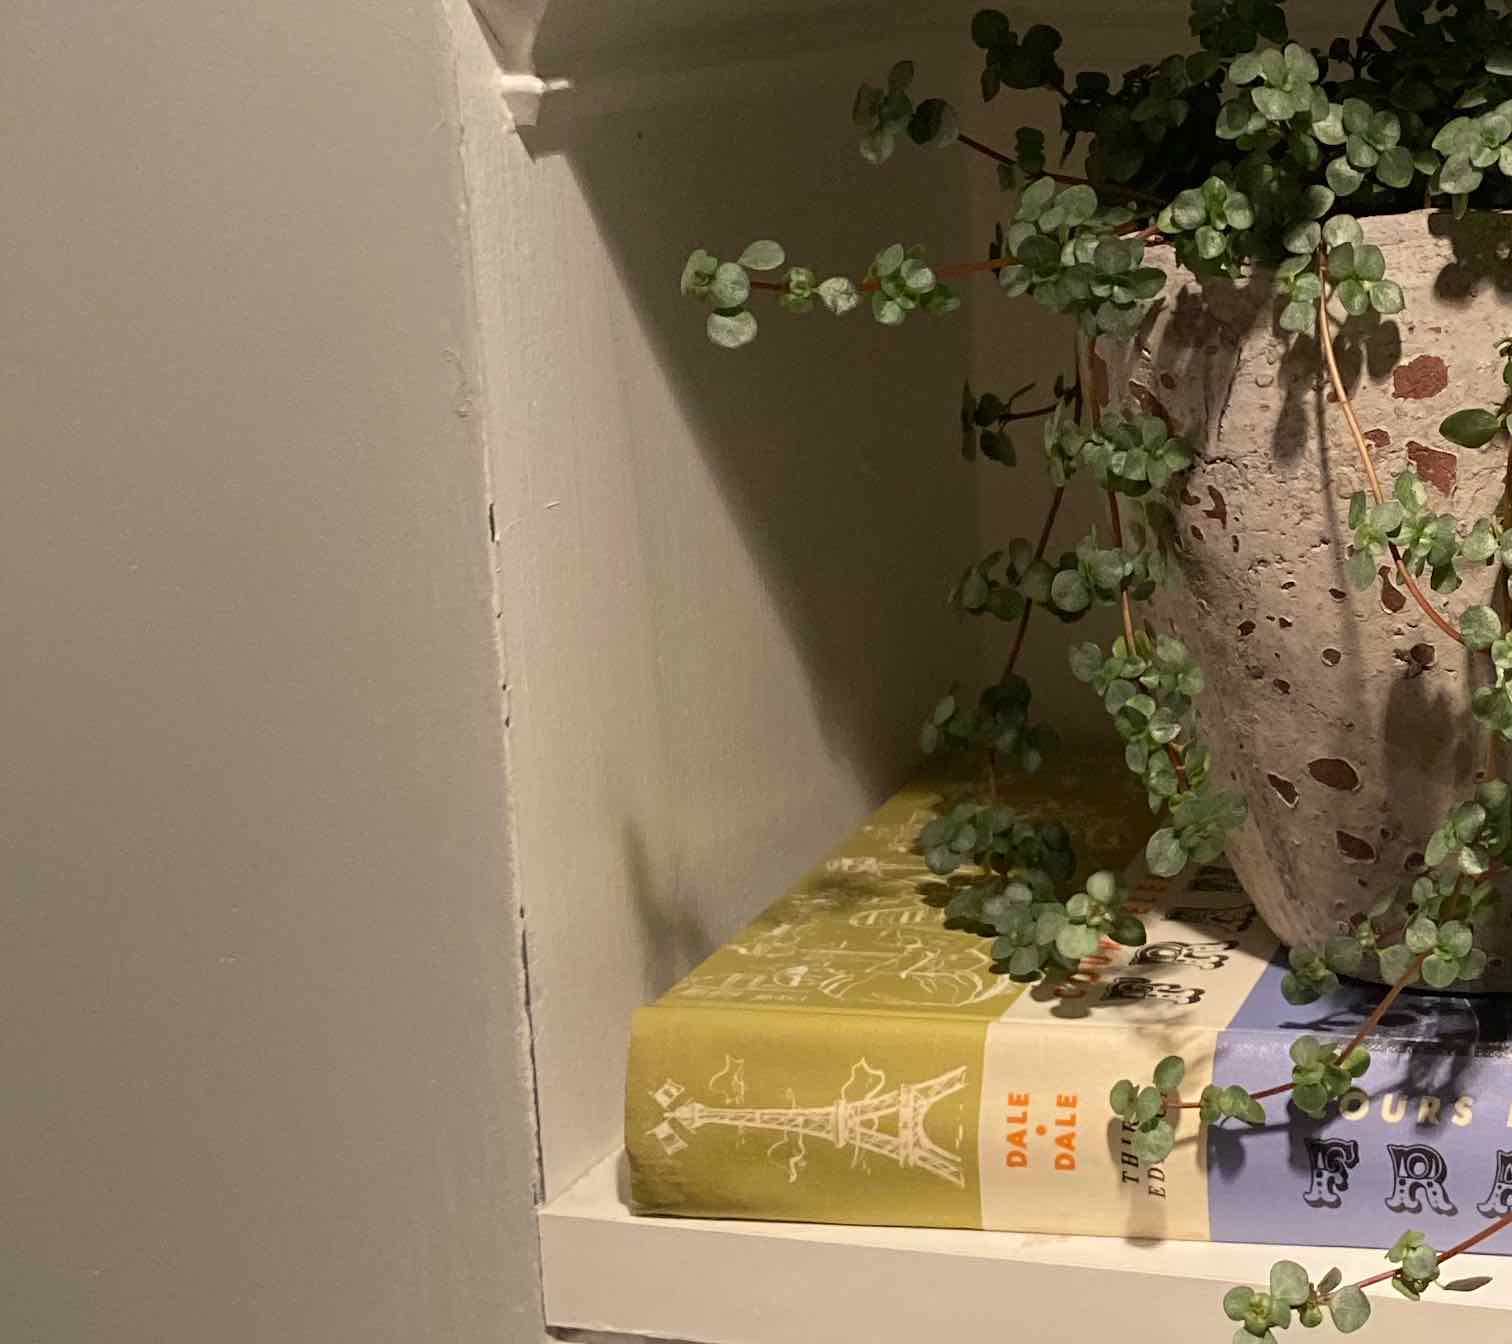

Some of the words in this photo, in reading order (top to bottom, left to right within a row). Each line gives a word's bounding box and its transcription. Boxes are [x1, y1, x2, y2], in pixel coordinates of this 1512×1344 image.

[1005, 1091, 1030, 1169] DALE
[1054, 1093, 1078, 1172] DALE
[1338, 1086, 1475, 1128] OURS
[1120, 1118, 1140, 1184] THIR
